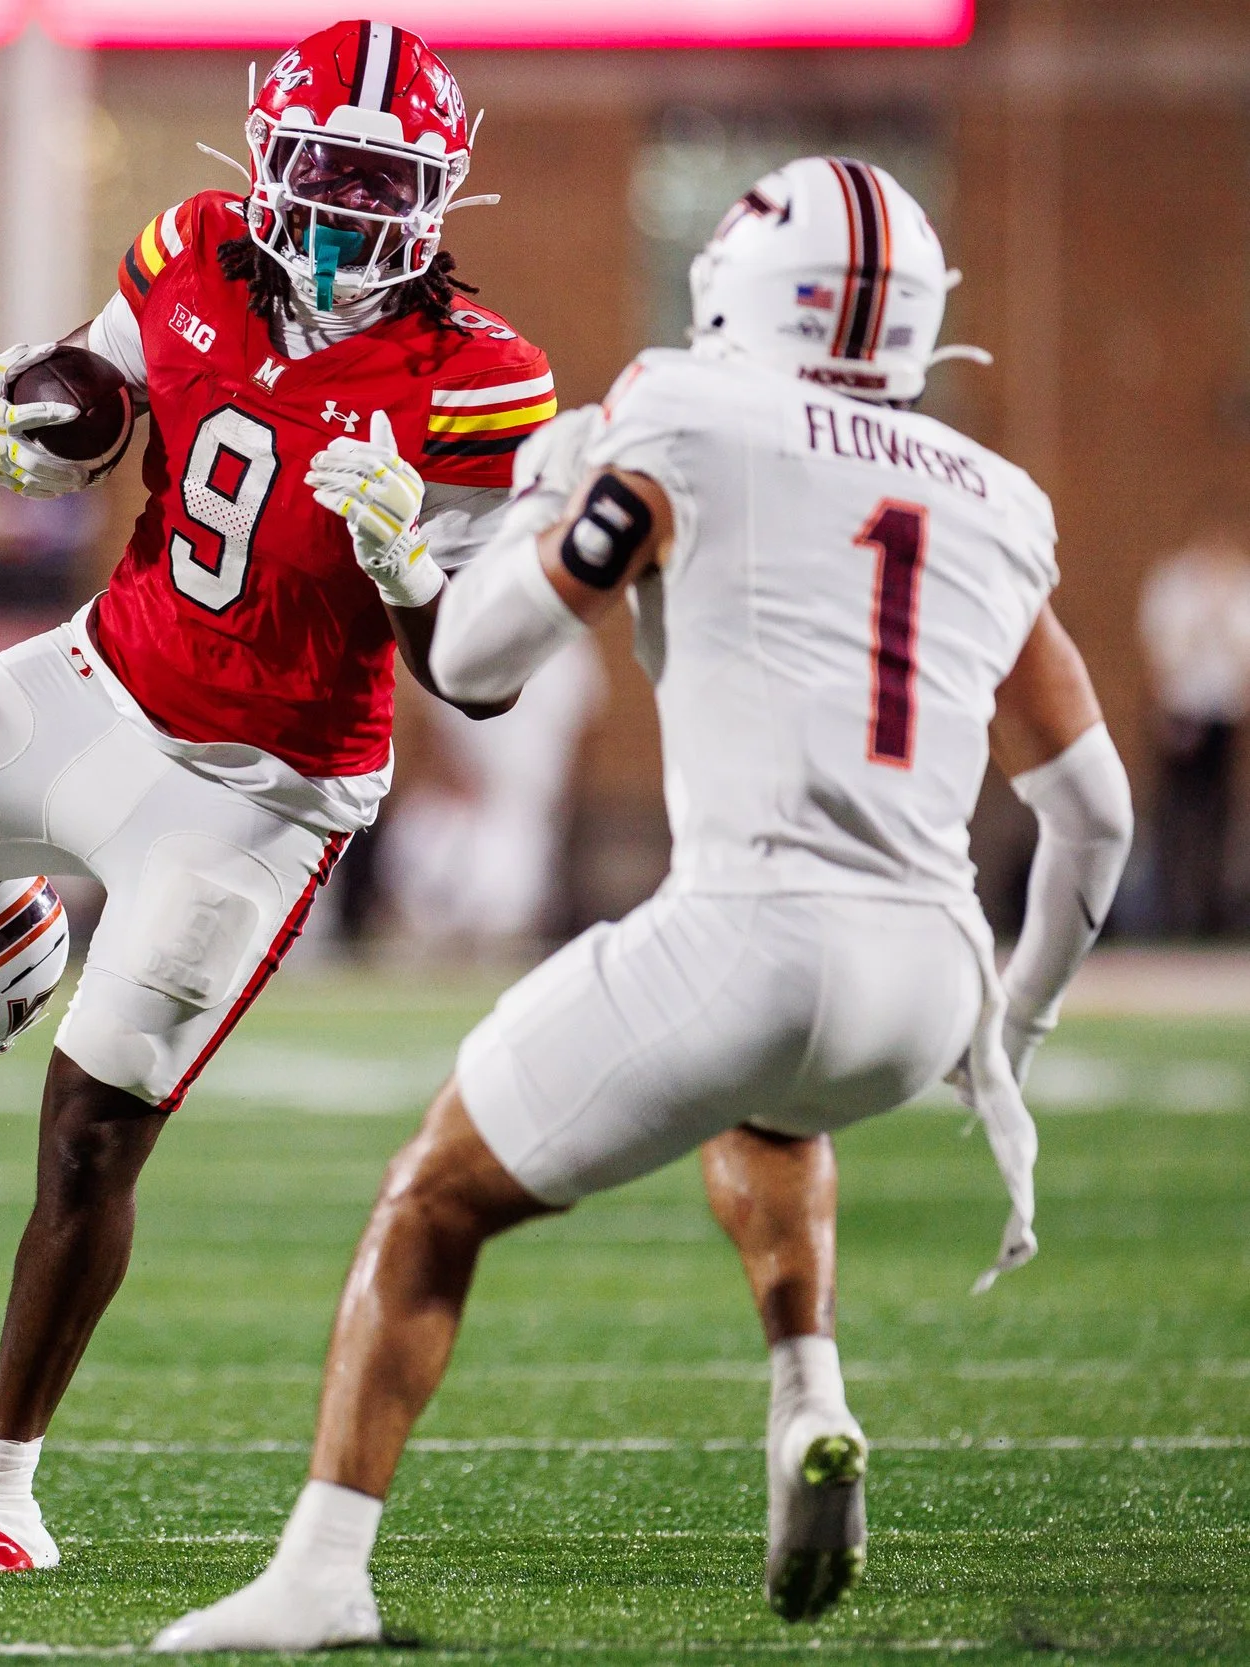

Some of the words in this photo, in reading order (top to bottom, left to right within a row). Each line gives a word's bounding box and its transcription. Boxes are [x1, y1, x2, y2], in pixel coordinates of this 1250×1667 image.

[450, 309, 518, 340] 9
[252, 356, 287, 390] M
[806, 403, 987, 499] FLOWERS
[168, 402, 282, 616] 9
[852, 497, 929, 771] 1
